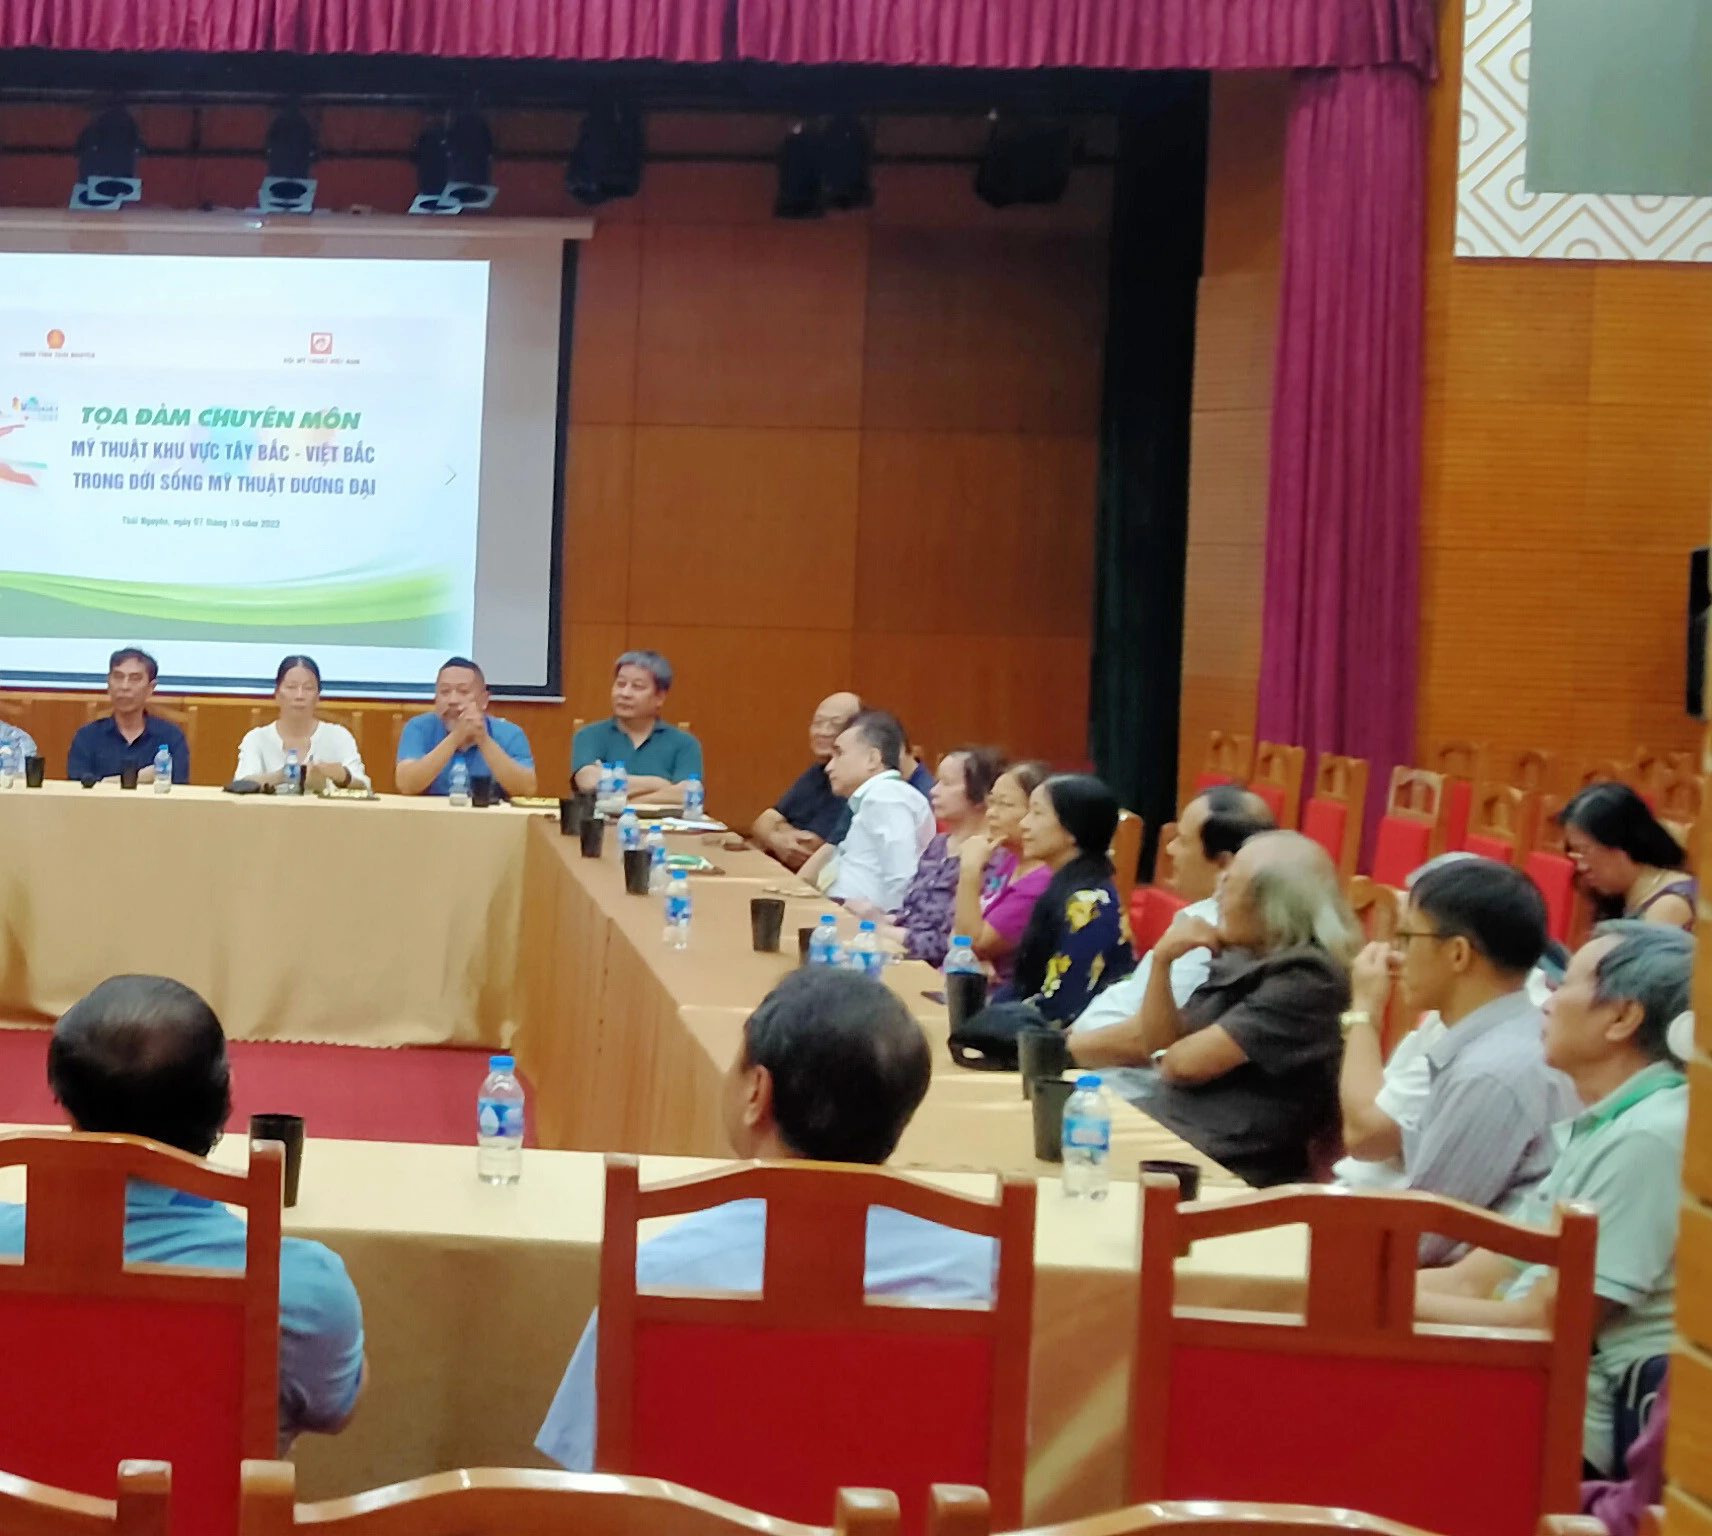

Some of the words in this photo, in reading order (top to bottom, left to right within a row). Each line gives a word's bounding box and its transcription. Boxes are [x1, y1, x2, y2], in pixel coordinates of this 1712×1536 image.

[82, 407, 128, 430] TỌA
[198, 406, 295, 428] CHUYÊN
[299, 406, 362, 429] MÔN
[71, 437, 95, 457] MỸ
[101, 438, 149, 463] THUẬT
[153, 441, 186, 460] KHU
[190, 441, 220, 463] VỰC
[225, 440, 253, 461] TÂY
[258, 438, 289, 462] BẮC
[306, 442, 339, 467] VIỆT
[344, 440, 375, 463] BẮC
[73, 472, 124, 490] TRONG
[160, 467, 203, 491] SỐNG
[208, 471, 233, 491] MỸ
[237, 473, 286, 497] THUẬT
[350, 478, 376, 500] ĐẠI
